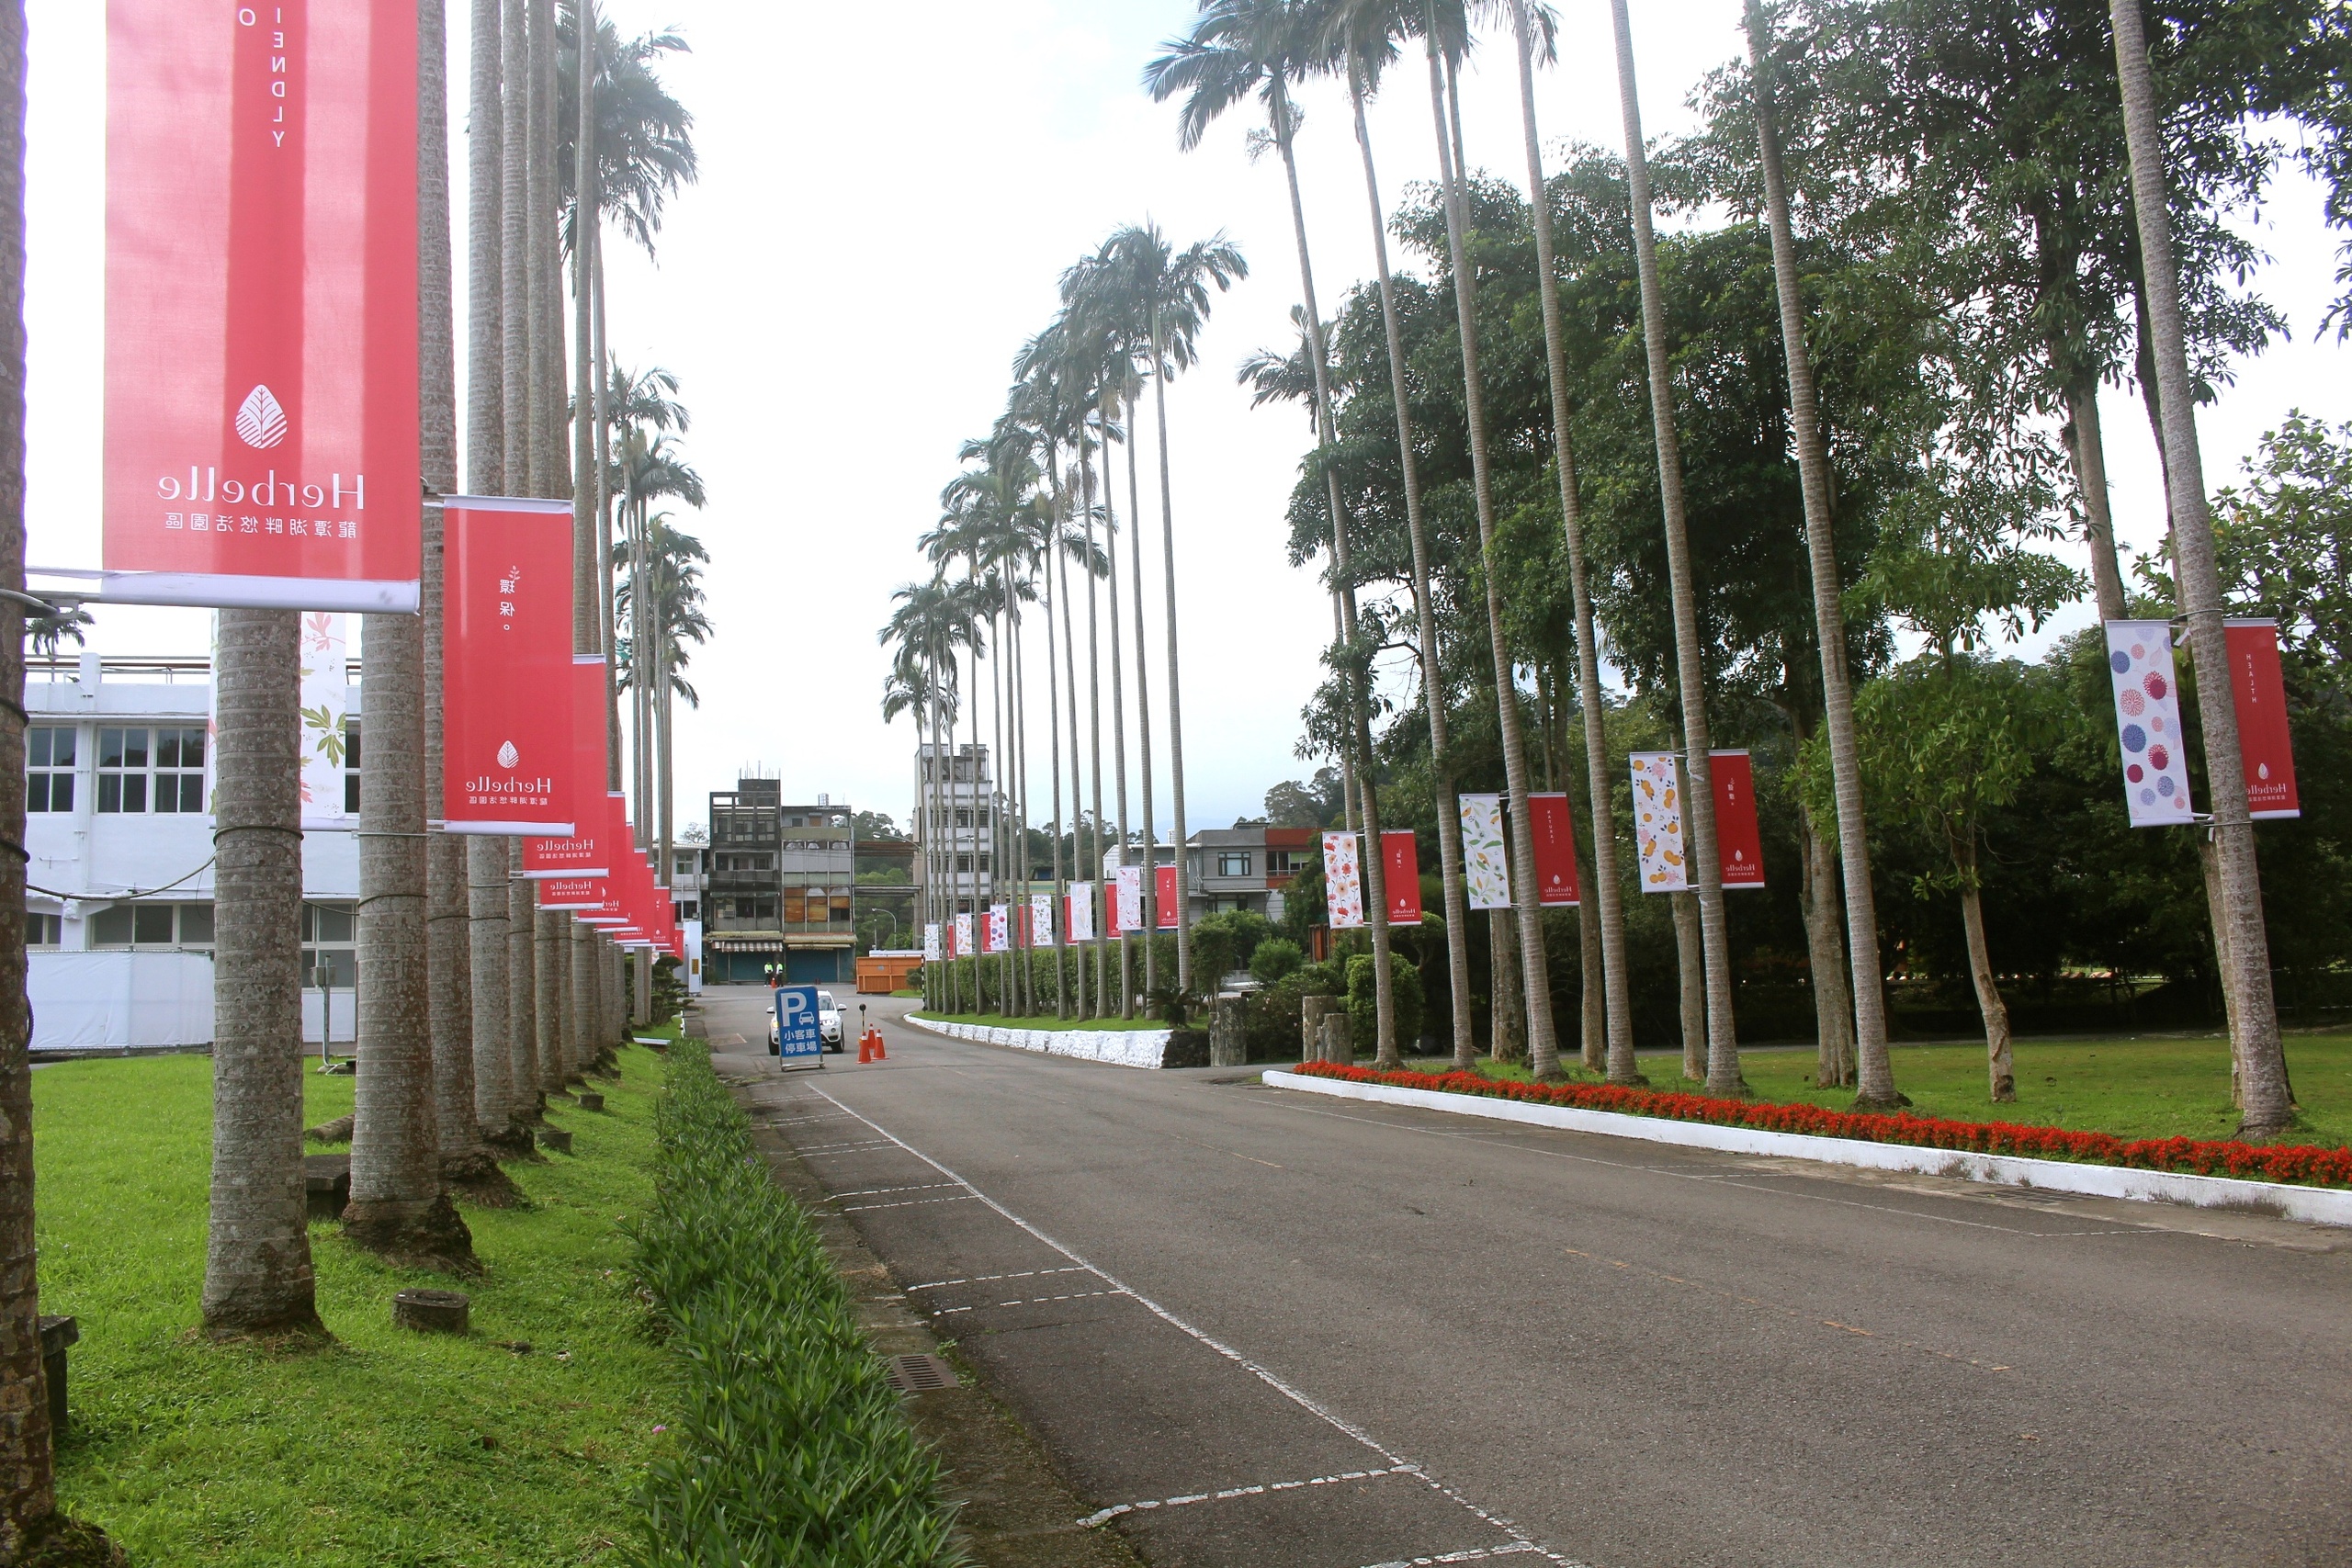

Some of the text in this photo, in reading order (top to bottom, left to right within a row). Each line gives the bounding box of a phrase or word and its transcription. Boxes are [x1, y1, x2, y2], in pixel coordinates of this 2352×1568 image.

[780, 992, 808, 1027] P
[784, 1028, 816, 1041] 小客車
[785, 1041, 818, 1055] 停車場
